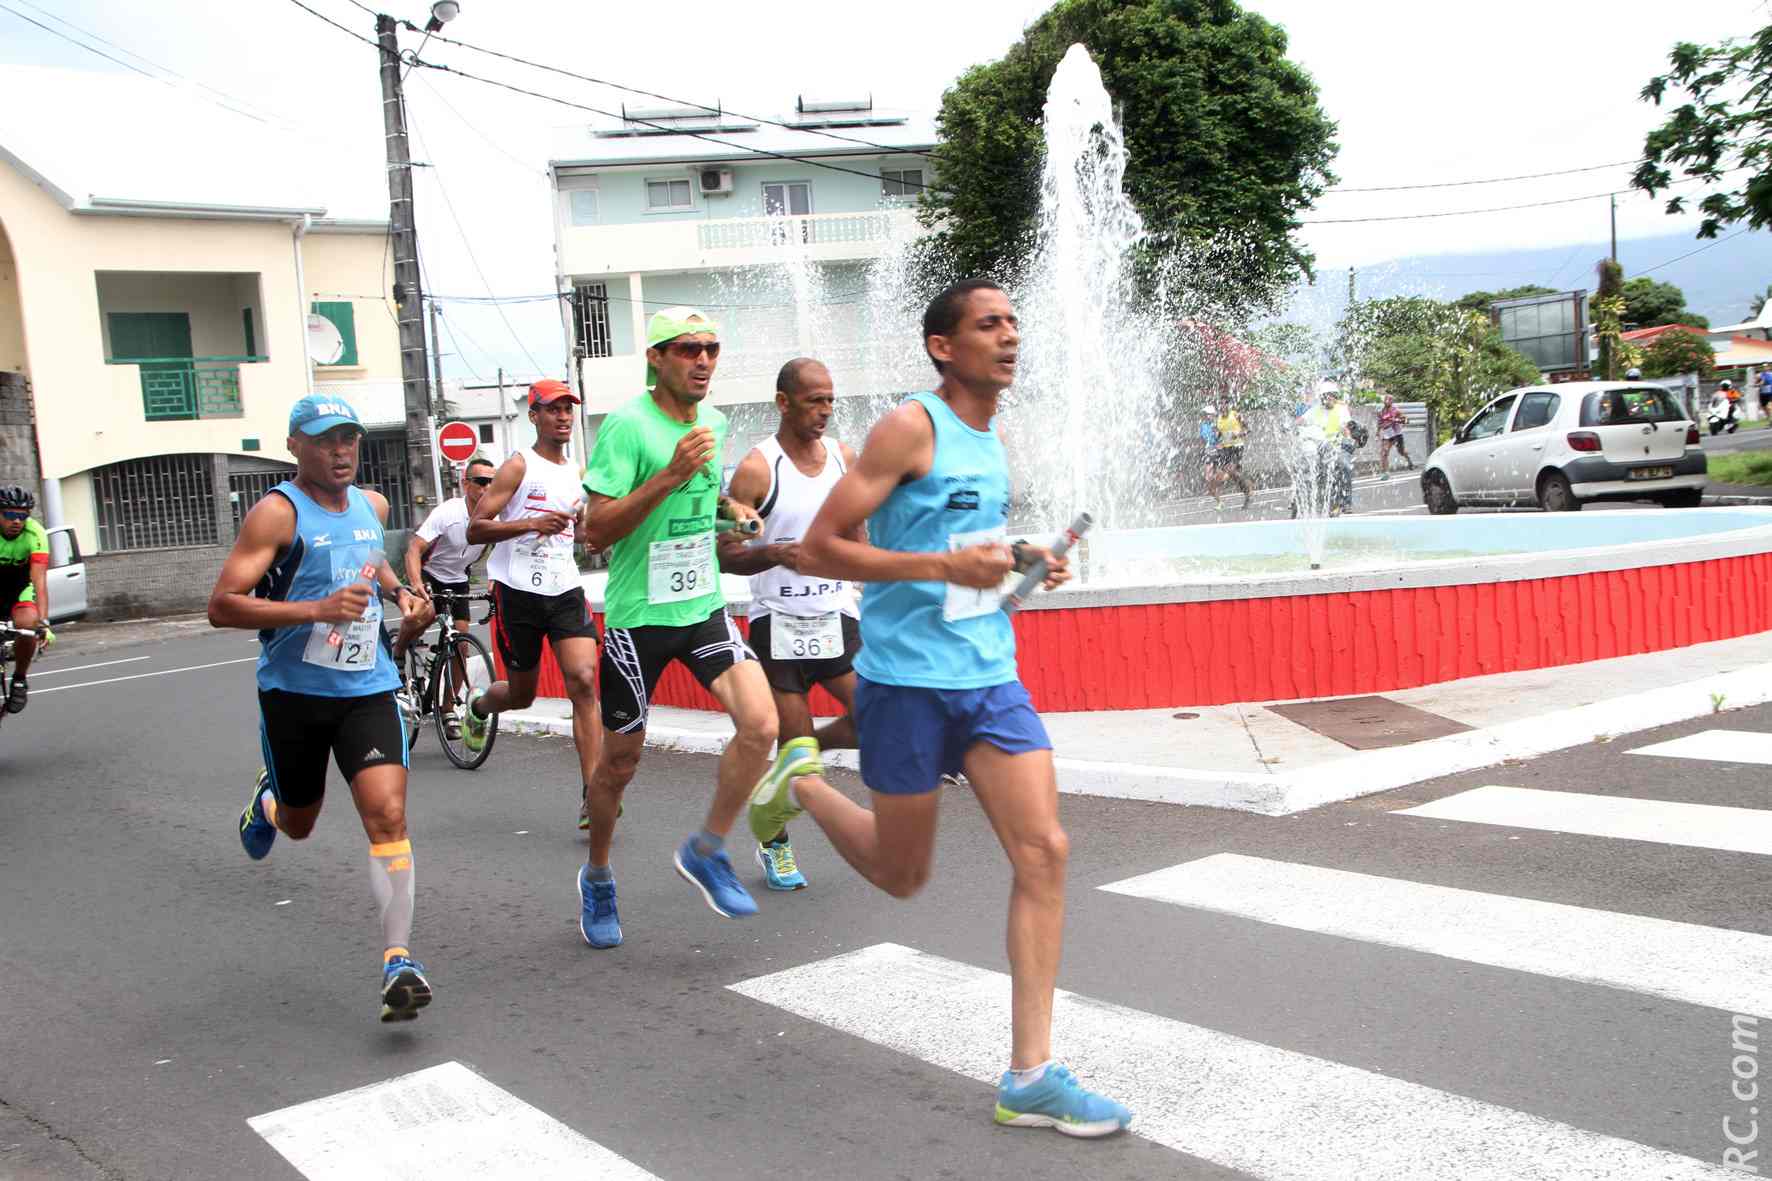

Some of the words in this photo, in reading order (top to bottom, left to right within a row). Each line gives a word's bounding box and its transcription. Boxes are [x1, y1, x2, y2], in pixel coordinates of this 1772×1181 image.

[316, 403, 352, 418] BNA
[353, 529, 378, 541] BNA
[531, 571, 543, 587] 6
[671, 569, 698, 592] 39
[792, 638, 821, 656] 36
